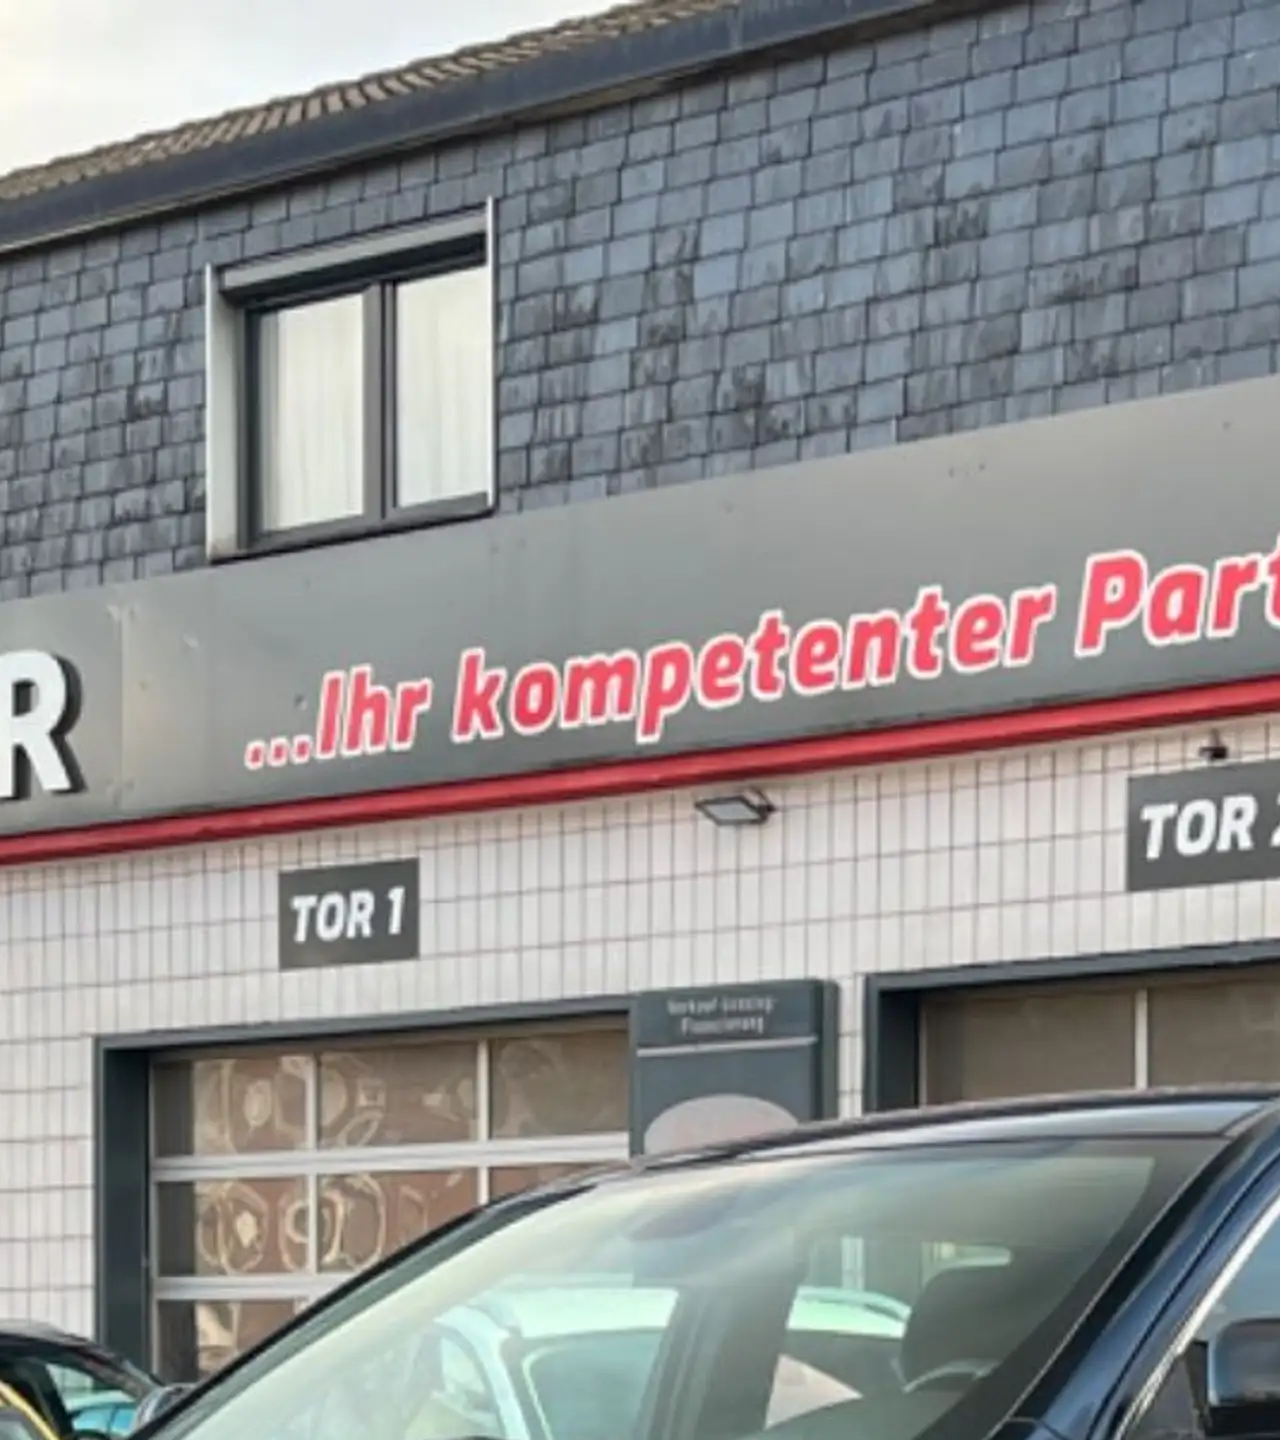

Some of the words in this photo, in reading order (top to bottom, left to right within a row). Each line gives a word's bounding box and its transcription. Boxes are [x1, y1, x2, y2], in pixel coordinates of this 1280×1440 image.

[452, 584, 1056, 744] kompetenter
[1141, 796, 1258, 860] TOR
[291, 890, 376, 942] TOR
[388, 887, 406, 935] 1
